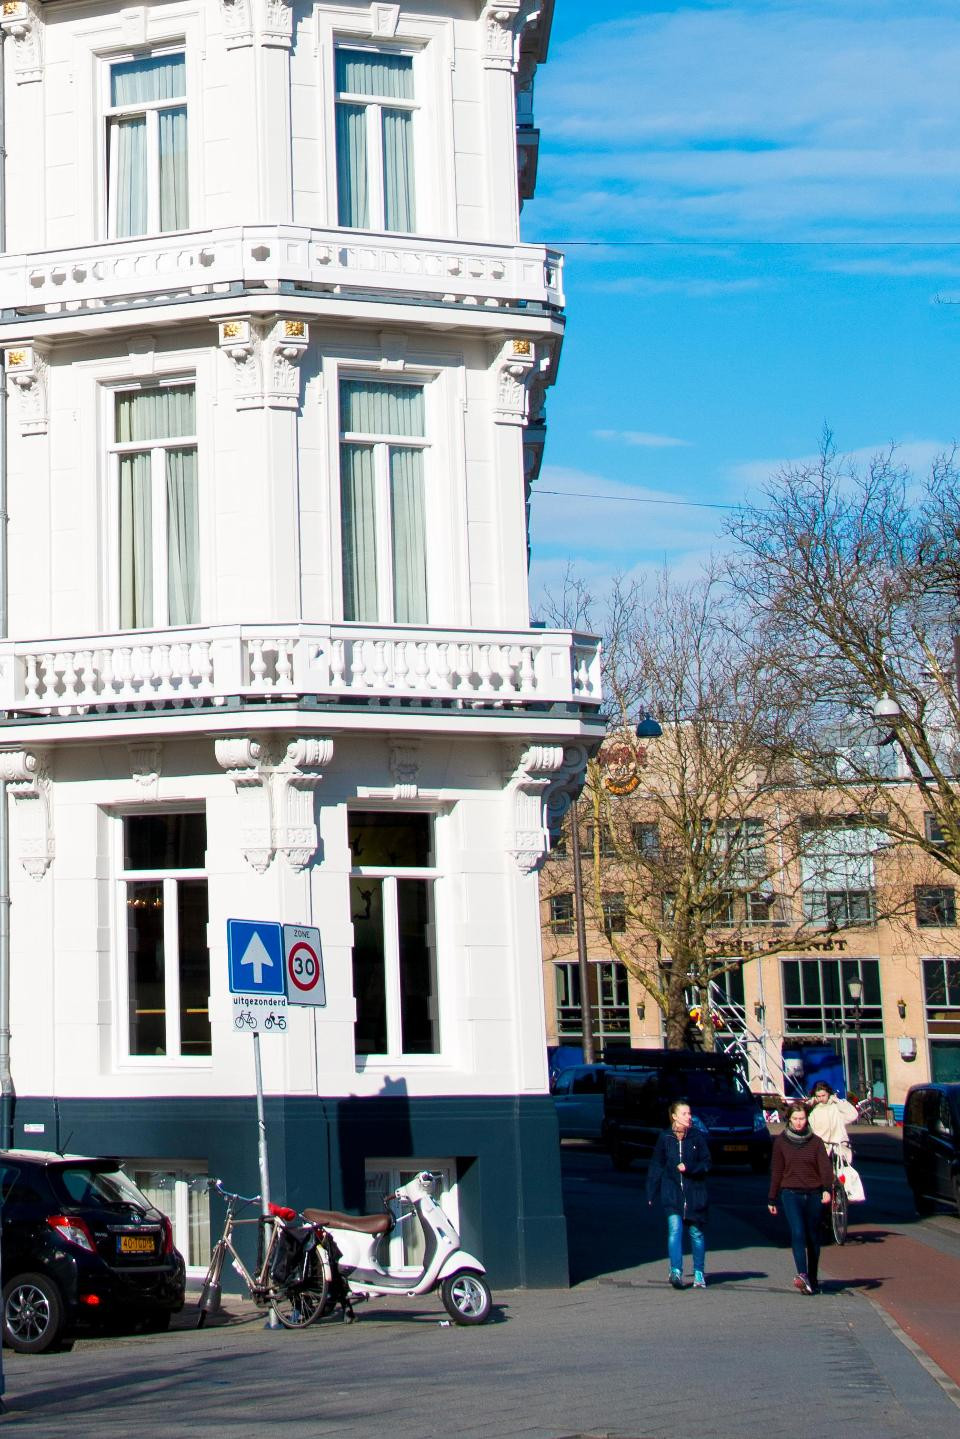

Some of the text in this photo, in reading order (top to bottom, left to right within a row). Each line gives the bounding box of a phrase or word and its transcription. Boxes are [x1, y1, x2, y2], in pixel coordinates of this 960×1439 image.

[294, 929, 310, 938] ZONE
[294, 957, 315, 976] 30
[233, 997, 286, 1007] uitgezonderd
